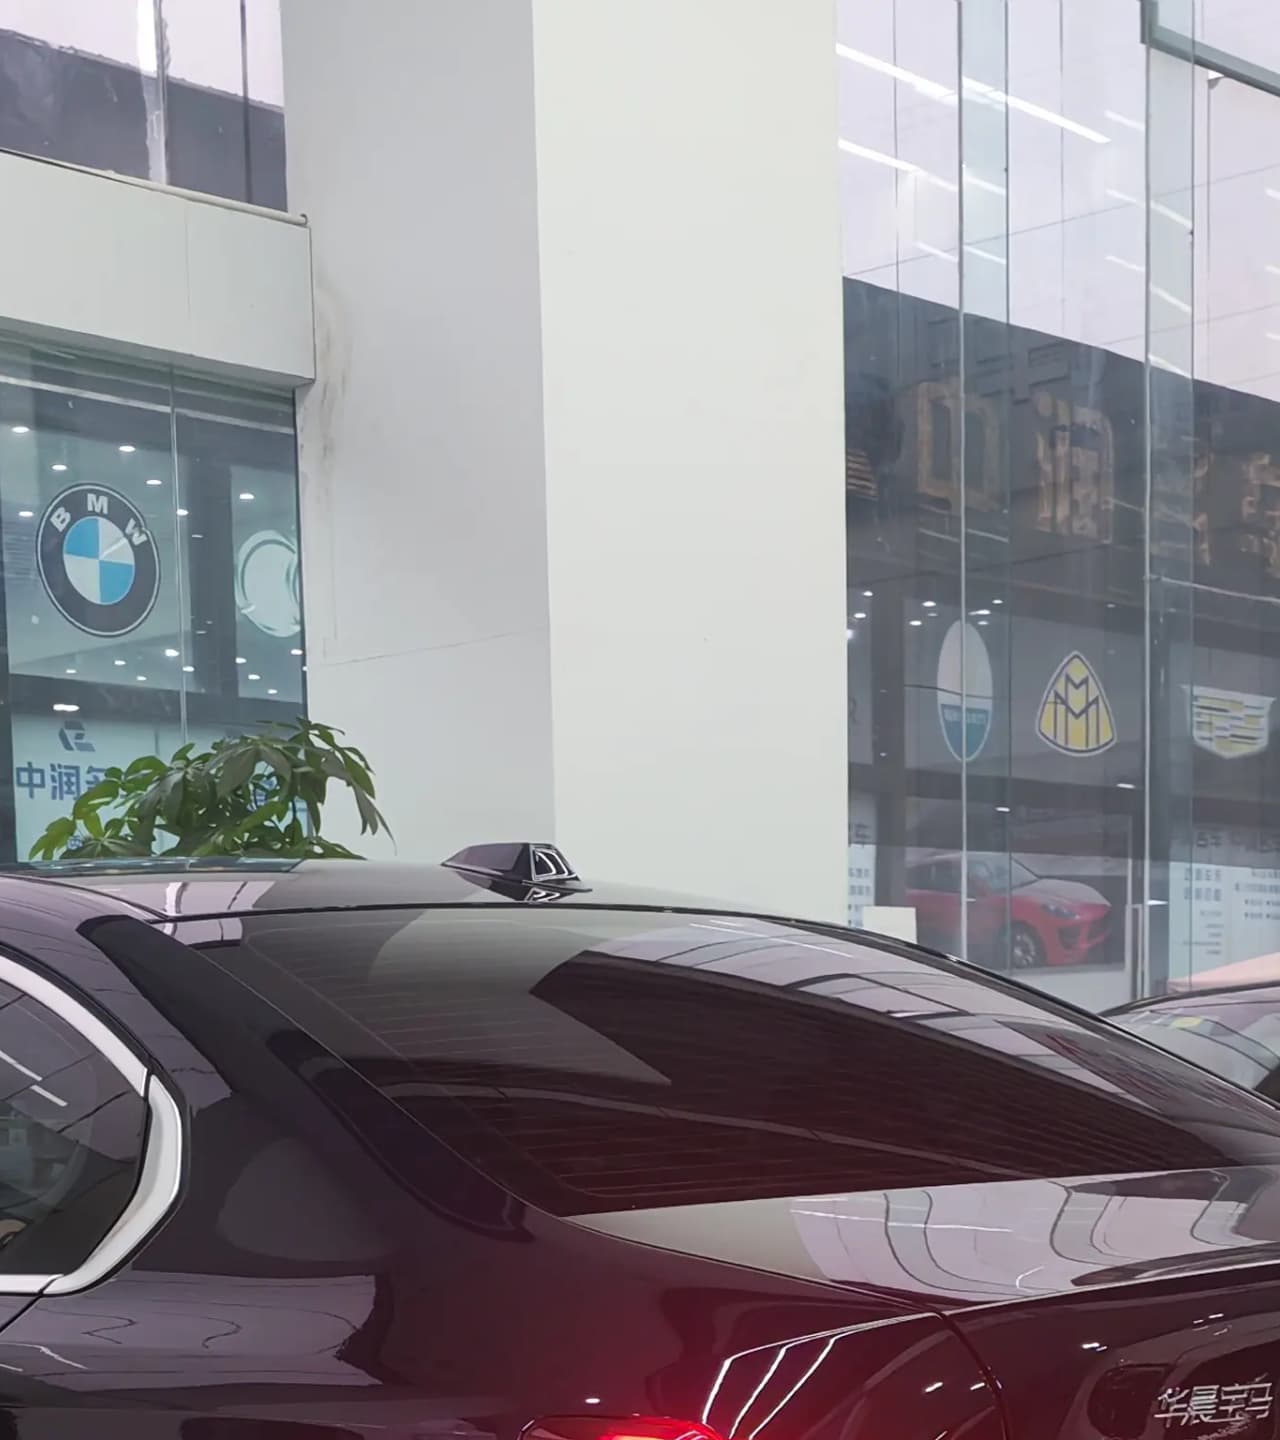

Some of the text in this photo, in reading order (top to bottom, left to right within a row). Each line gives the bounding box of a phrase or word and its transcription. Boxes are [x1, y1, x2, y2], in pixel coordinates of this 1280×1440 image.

[49, 492, 148, 547] BMW
[15, 761, 115, 802] 中润
[1153, 1382, 1274, 1430] 华晨宝马
